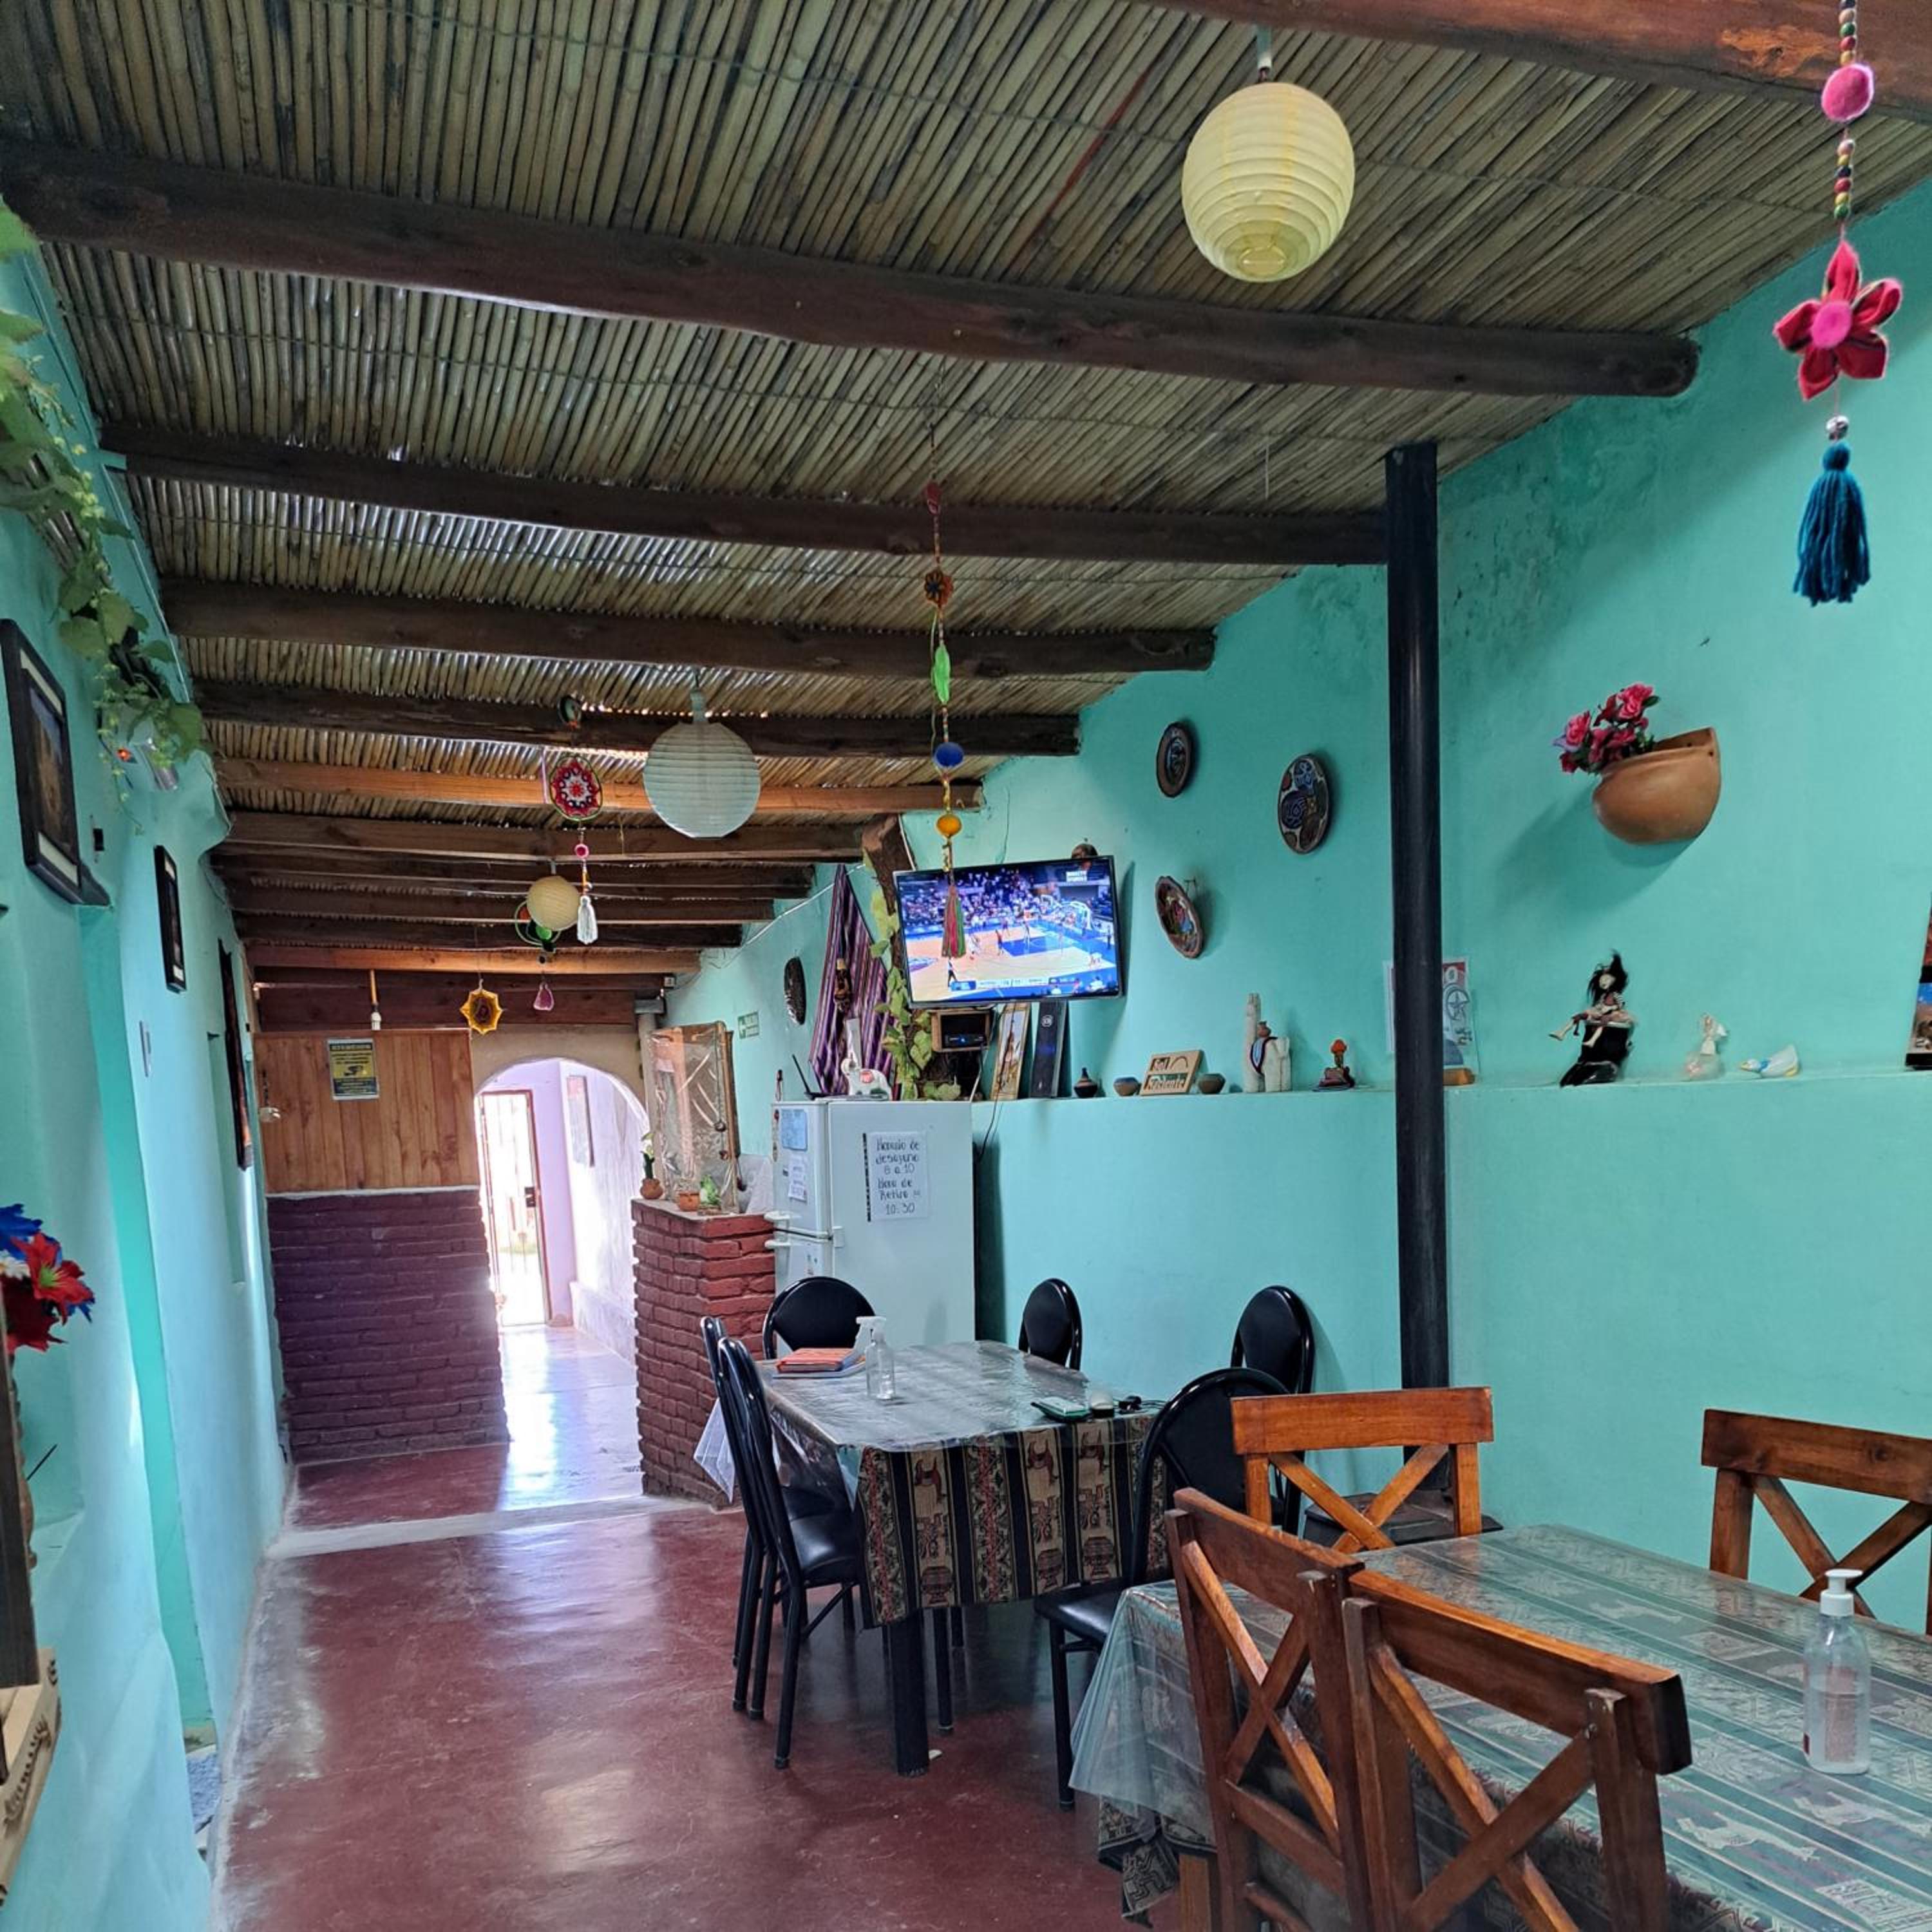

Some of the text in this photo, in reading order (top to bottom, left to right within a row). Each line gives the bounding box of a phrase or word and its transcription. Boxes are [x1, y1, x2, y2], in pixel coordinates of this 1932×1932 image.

[910, 1140, 919, 1150] de
[904, 1162, 915, 1174] 10
[902, 1178, 912, 1188] de
